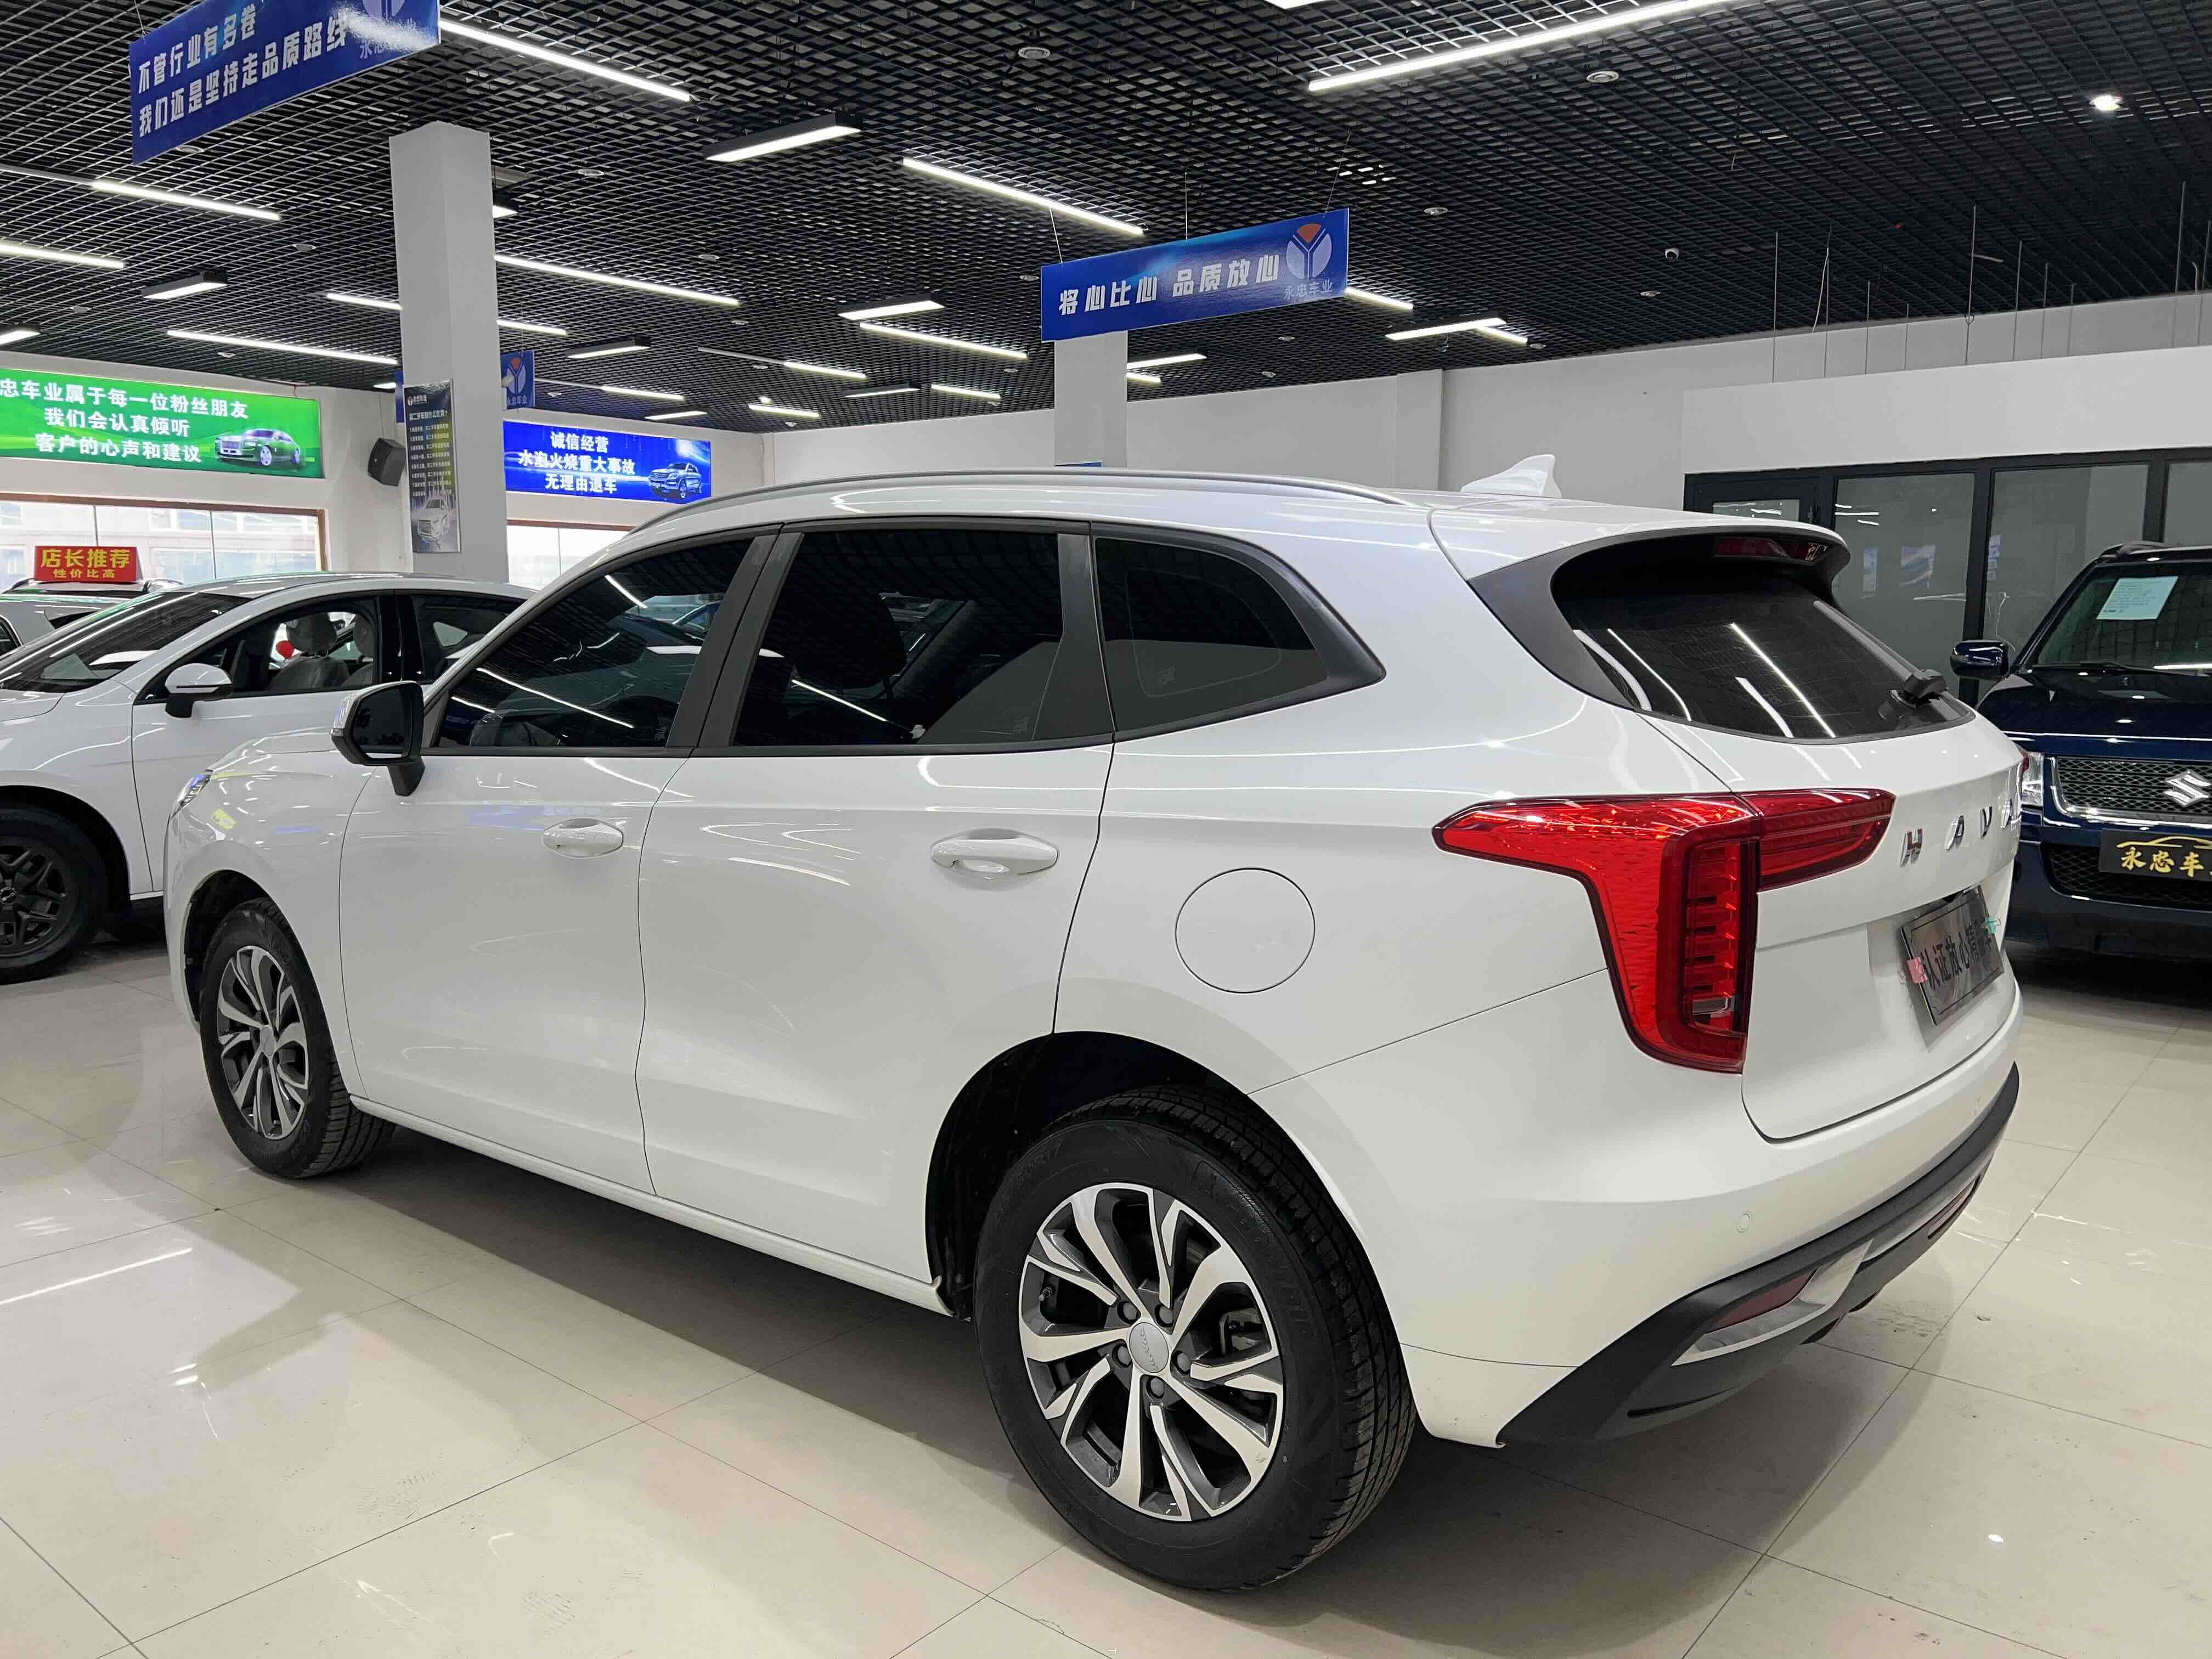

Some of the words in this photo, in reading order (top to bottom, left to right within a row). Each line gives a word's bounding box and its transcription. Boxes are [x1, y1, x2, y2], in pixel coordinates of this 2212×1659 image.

[138, 3, 256, 93] 不管行业有多卷
[139, 13, 347, 138] 我们还是坚持走品质路线
[1059, 276, 1158, 315] 将心比心
[1172, 254, 1279, 297] 品质放心
[1284, 279, 1334, 300] 永忠车业
[44, 407, 190, 437] 我们会认真倾听
[35, 432, 201, 462] 客户的心声和建议
[550, 431, 608, 453] 诚信经营
[518, 449, 635, 475] 水泡火烧重大事故
[545, 473, 617, 494] 无理由退车
[41, 548, 131, 568] 店长推荐
[53, 568, 115, 579] 性价比高
[2121, 847, 2212, 878] 永忠车
